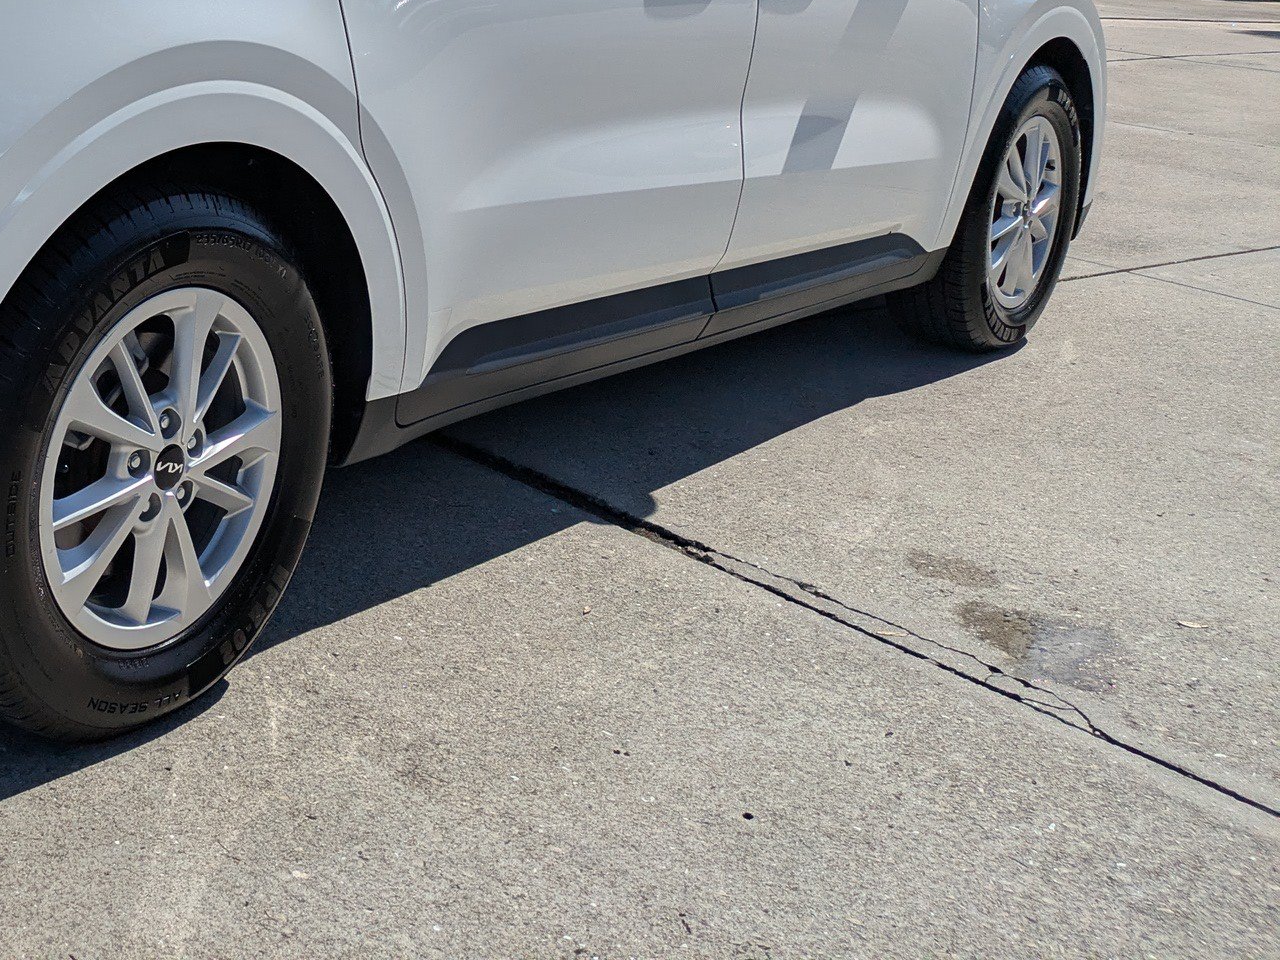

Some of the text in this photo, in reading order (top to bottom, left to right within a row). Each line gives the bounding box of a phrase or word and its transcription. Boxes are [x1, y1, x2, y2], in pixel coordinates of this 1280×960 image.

[40, 246, 165, 397] ADVANTA
[86, 690, 182, 715] ALL SEASON
